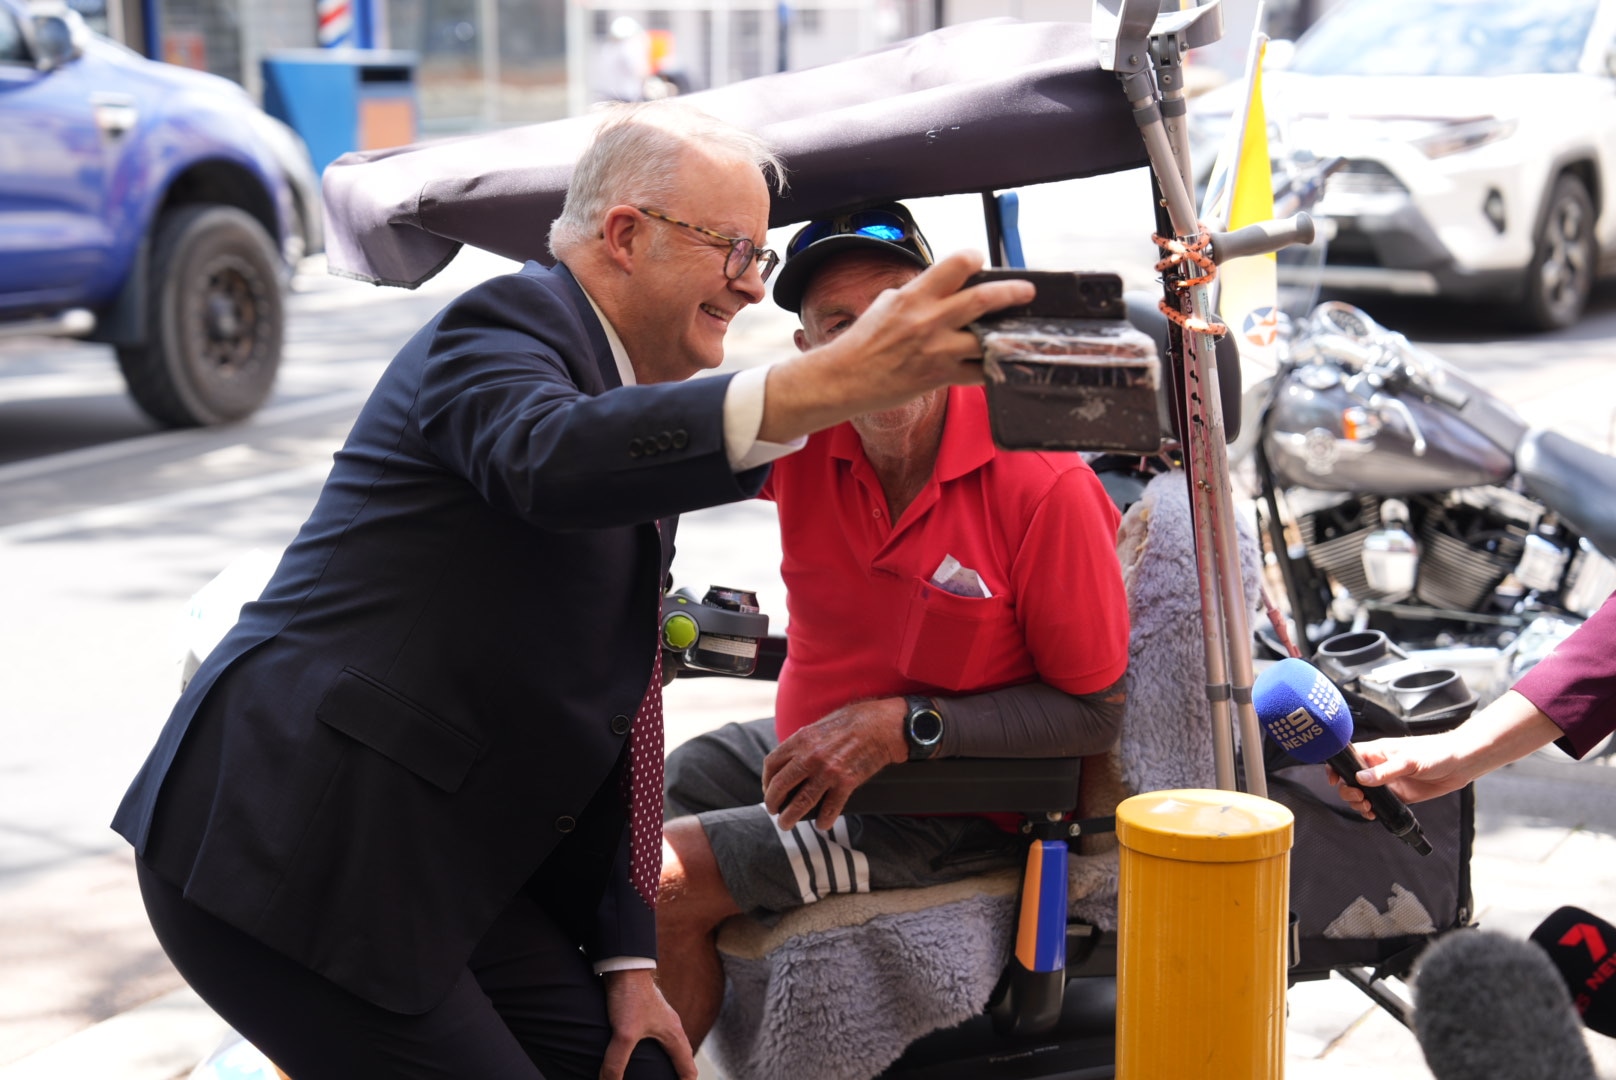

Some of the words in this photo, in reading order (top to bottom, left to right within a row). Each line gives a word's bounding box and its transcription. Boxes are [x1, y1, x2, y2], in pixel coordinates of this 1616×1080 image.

[1286, 706, 1315, 732] 9
[1281, 724, 1324, 751] NEWS
[1558, 922, 1609, 964] 7
